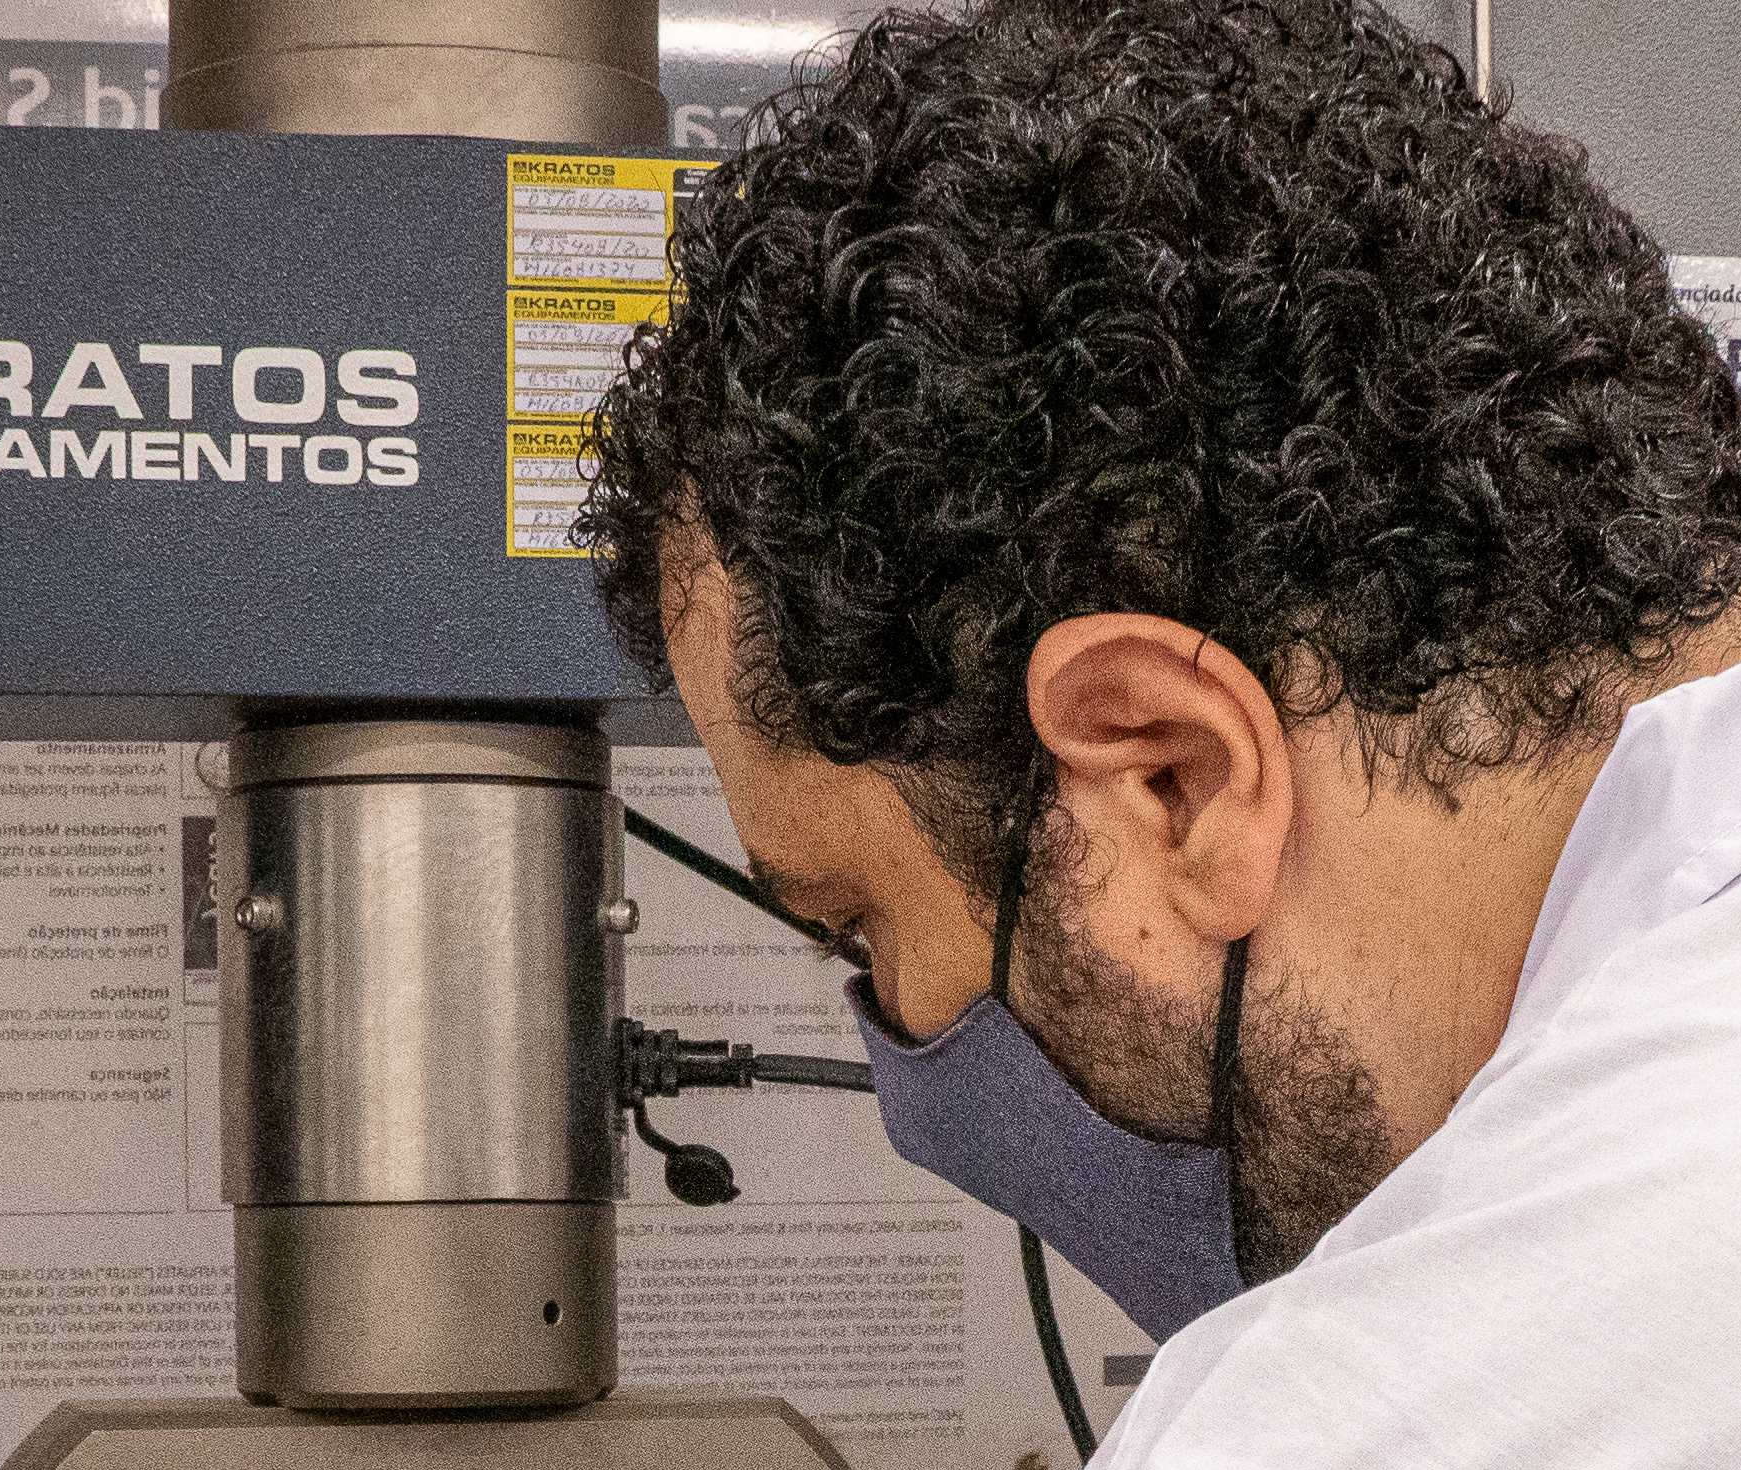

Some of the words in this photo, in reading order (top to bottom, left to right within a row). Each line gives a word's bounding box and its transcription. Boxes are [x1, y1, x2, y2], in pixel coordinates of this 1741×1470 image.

[528, 161, 616, 176] KRATOS
[513, 174, 615, 186] EQUIPAMENTOS
[529, 297, 616, 312] KRATOS
[513, 310, 616, 321] EQUIPAMENTOS
[528, 432, 589, 446] KRAT
[513, 446, 593, 457] EQUIPAMEN
